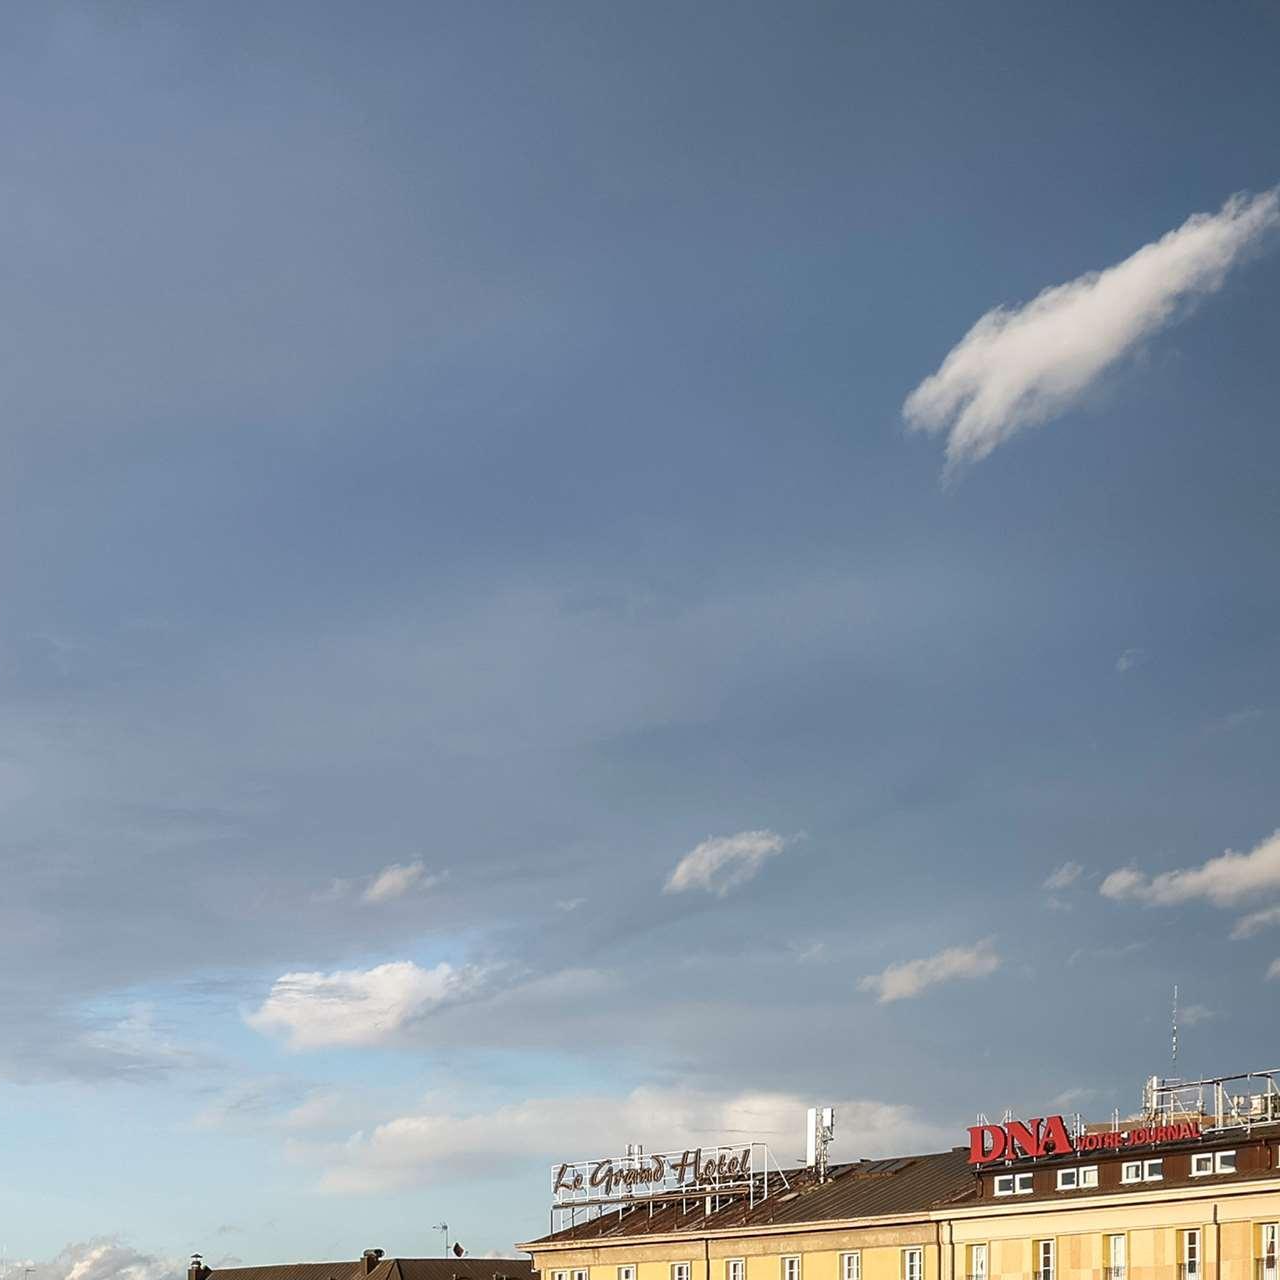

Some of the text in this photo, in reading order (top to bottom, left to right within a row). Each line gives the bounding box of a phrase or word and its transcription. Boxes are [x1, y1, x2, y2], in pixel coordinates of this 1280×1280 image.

[968, 1116, 1074, 1165] DNA
[1077, 1121, 1202, 1151] VOTRE JOURNAL
[554, 1163, 583, 1194] Le
[588, 1155, 666, 1196] Grand
